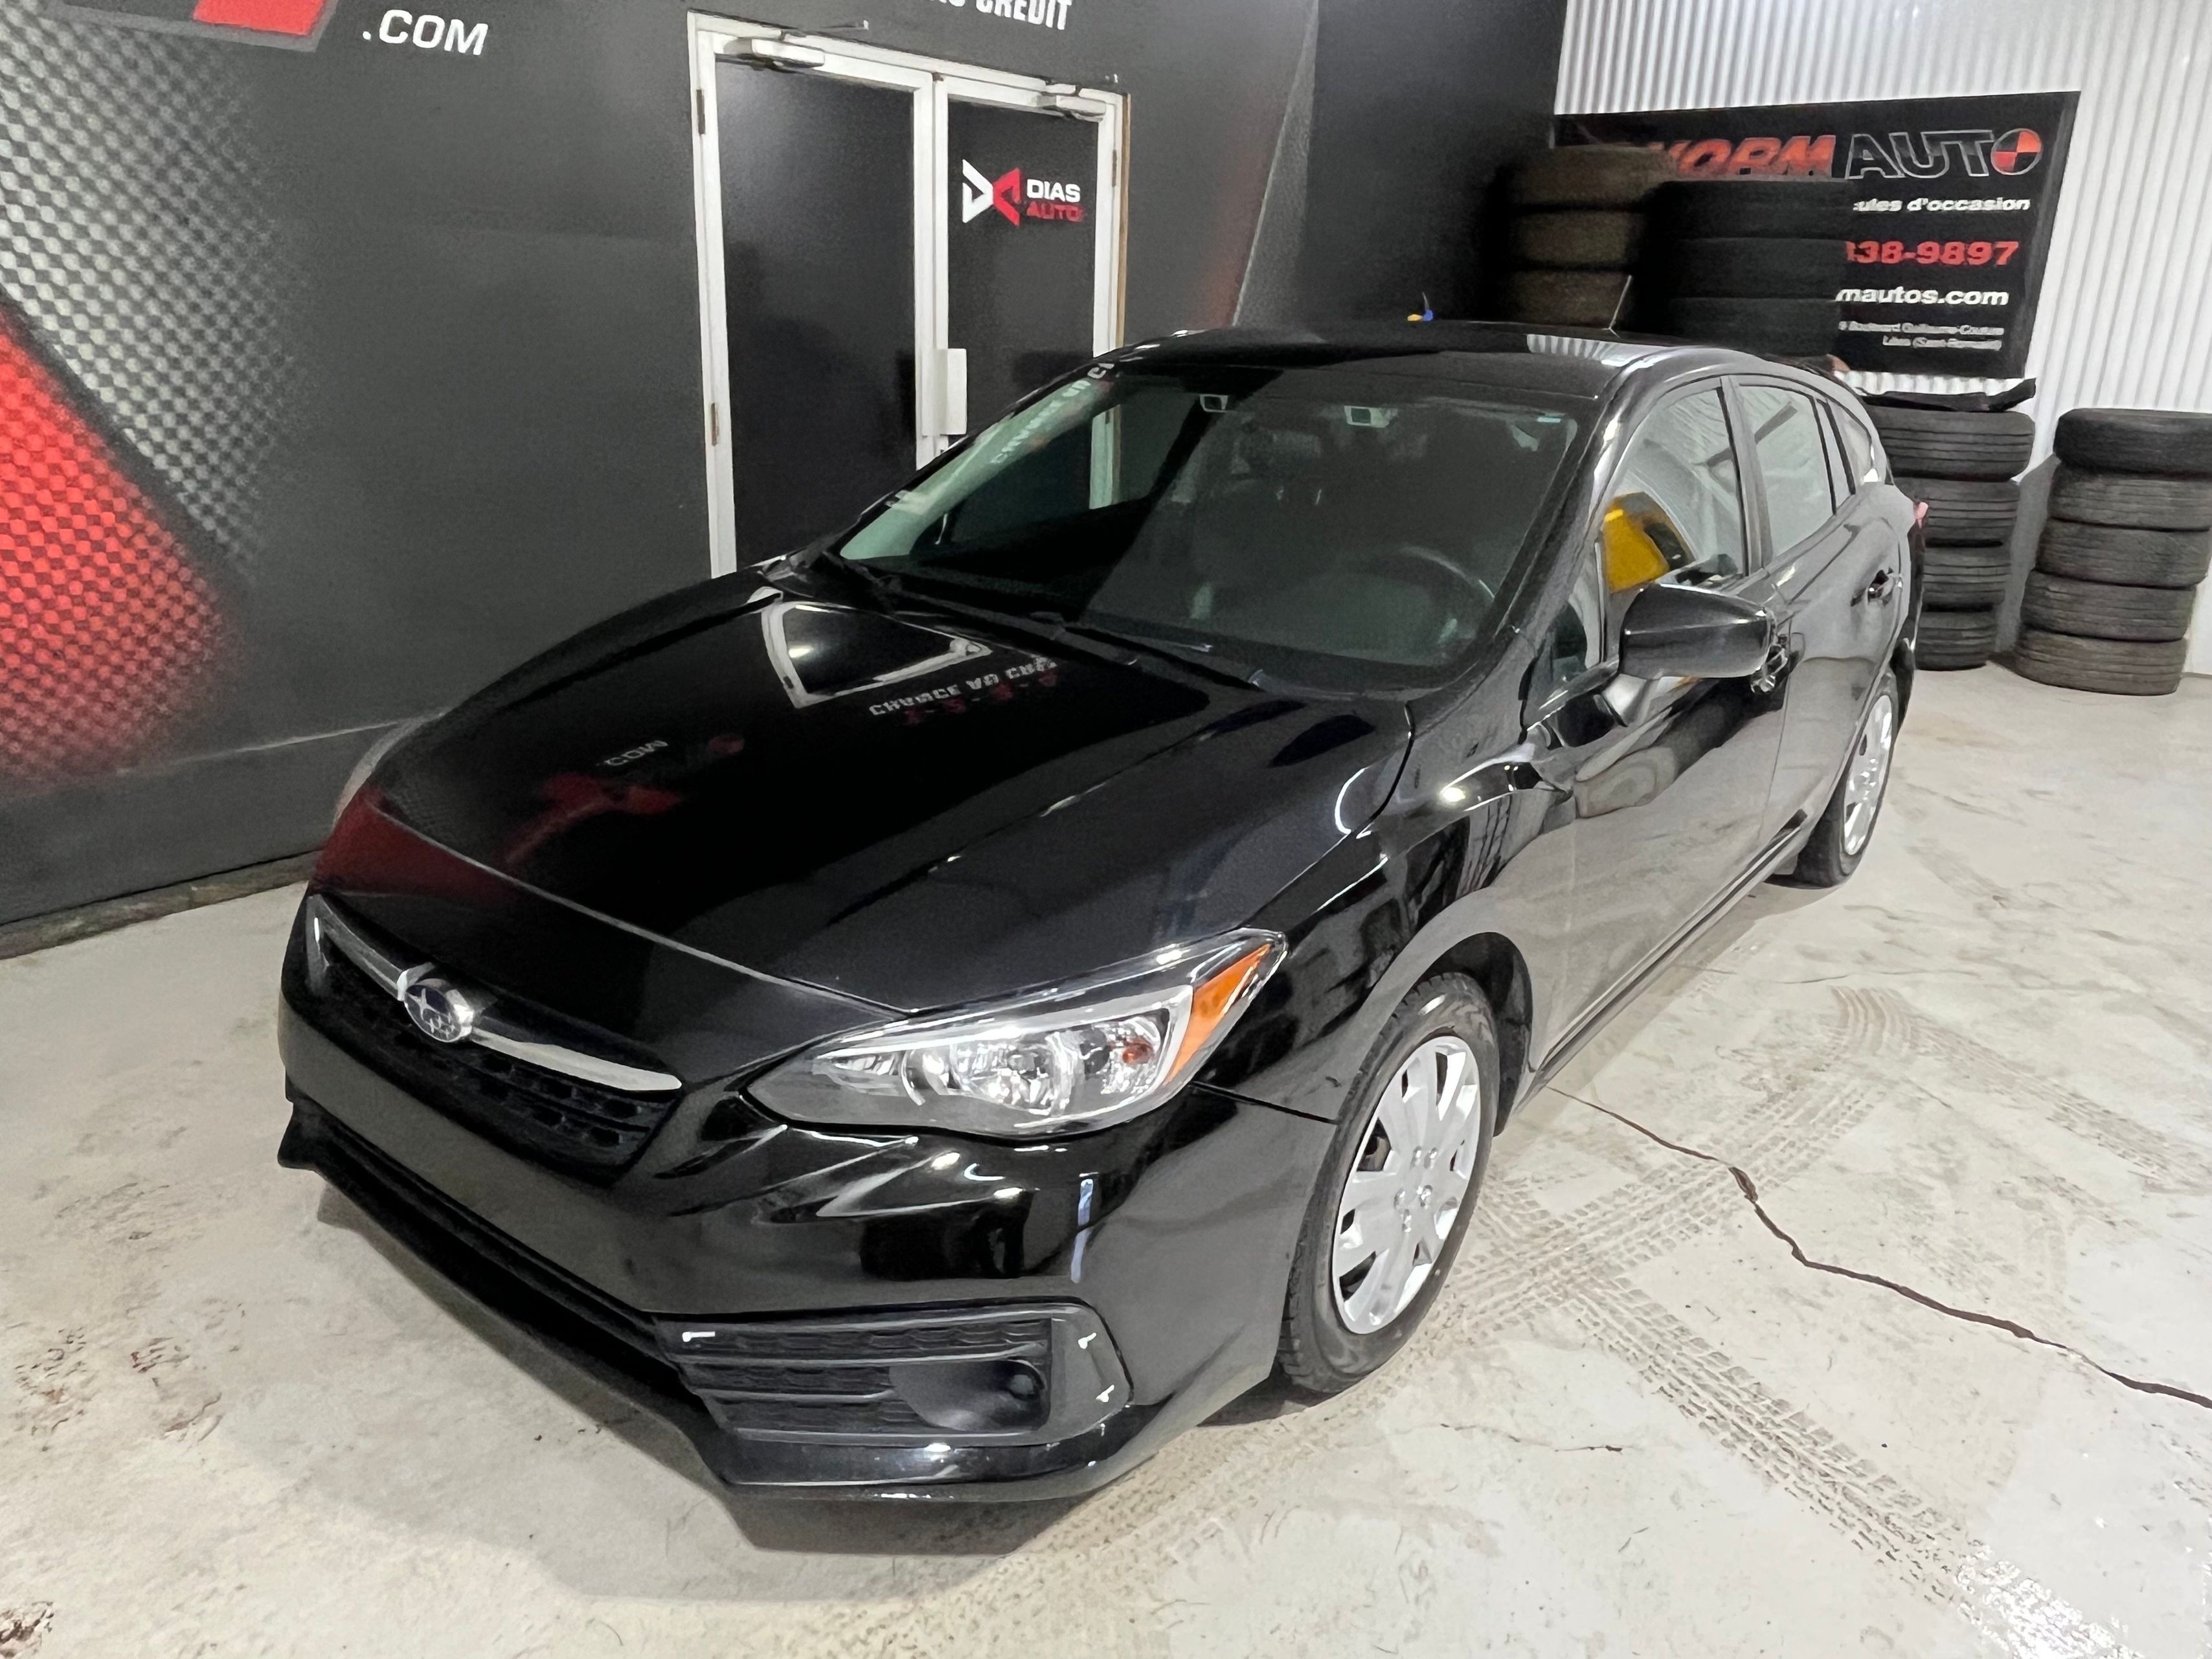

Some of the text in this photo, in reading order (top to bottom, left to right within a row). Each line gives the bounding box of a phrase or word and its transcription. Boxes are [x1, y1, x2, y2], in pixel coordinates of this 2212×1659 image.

[362, 9, 489, 56] .COM
[1845, 128, 2044, 180] AUTO
[1026, 179, 1081, 203] DIAS
[1026, 201, 1086, 223] AUTO
[1906, 197, 2031, 211] d'occasion
